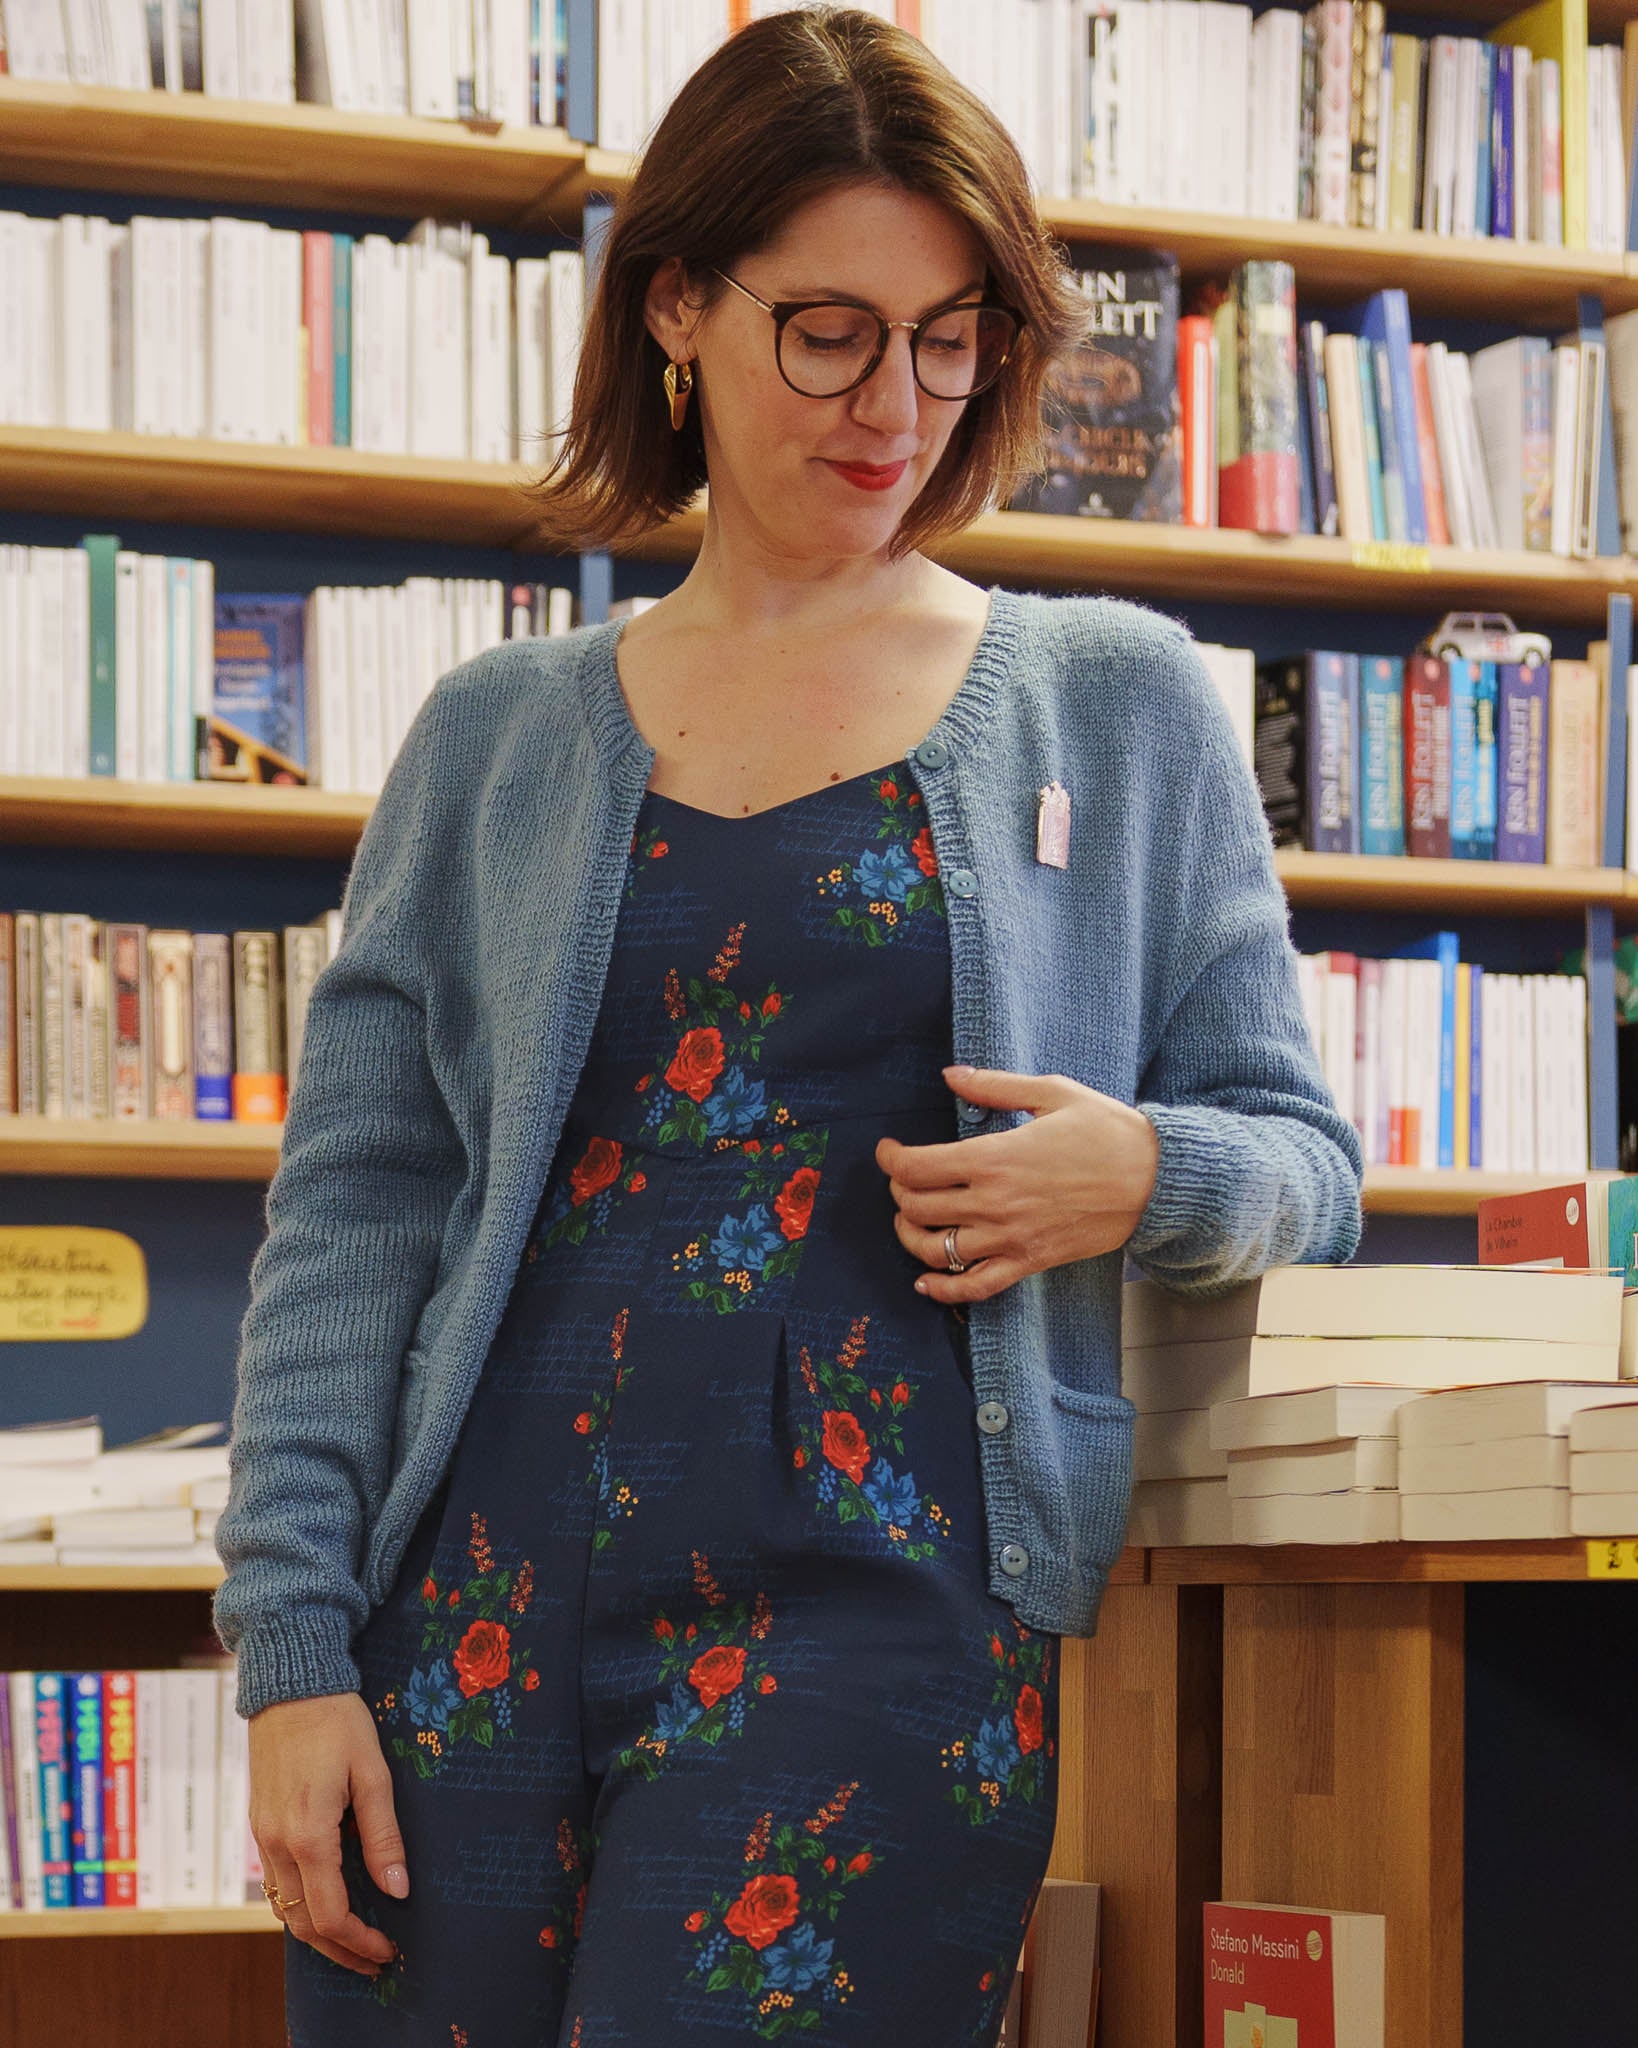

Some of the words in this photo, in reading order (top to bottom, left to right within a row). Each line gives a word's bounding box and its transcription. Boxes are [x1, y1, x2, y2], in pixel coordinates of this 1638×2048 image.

[1211, 1928, 1249, 1954] Stefano
[1251, 1933, 1300, 1960] Massini
[1211, 1959, 1245, 1985] Donald
